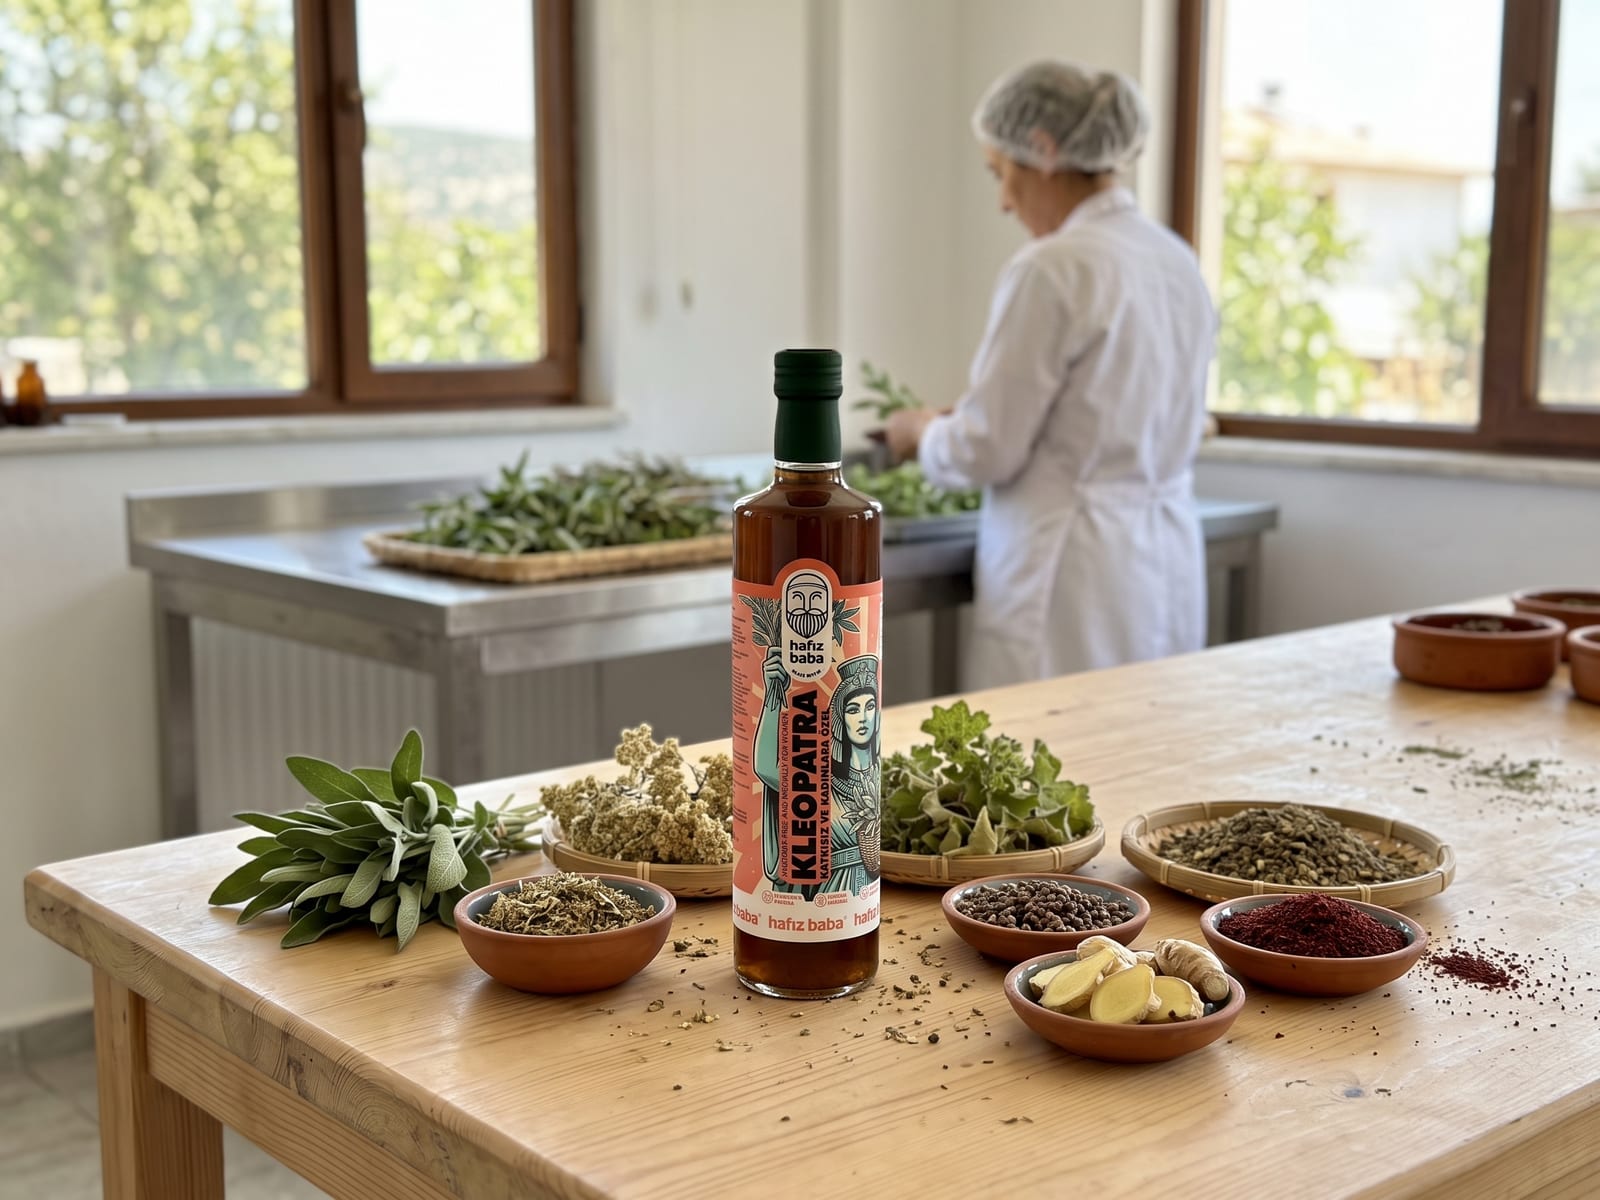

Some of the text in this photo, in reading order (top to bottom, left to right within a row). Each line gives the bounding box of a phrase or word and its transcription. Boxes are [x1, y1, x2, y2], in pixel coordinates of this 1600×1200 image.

[790, 652, 824, 664] baba
[792, 690, 817, 879] KLEOPATRA
[818, 709, 829, 879] KATKISIZ VE KADINLARA ÖZEL
[808, 916, 844, 932] baba
